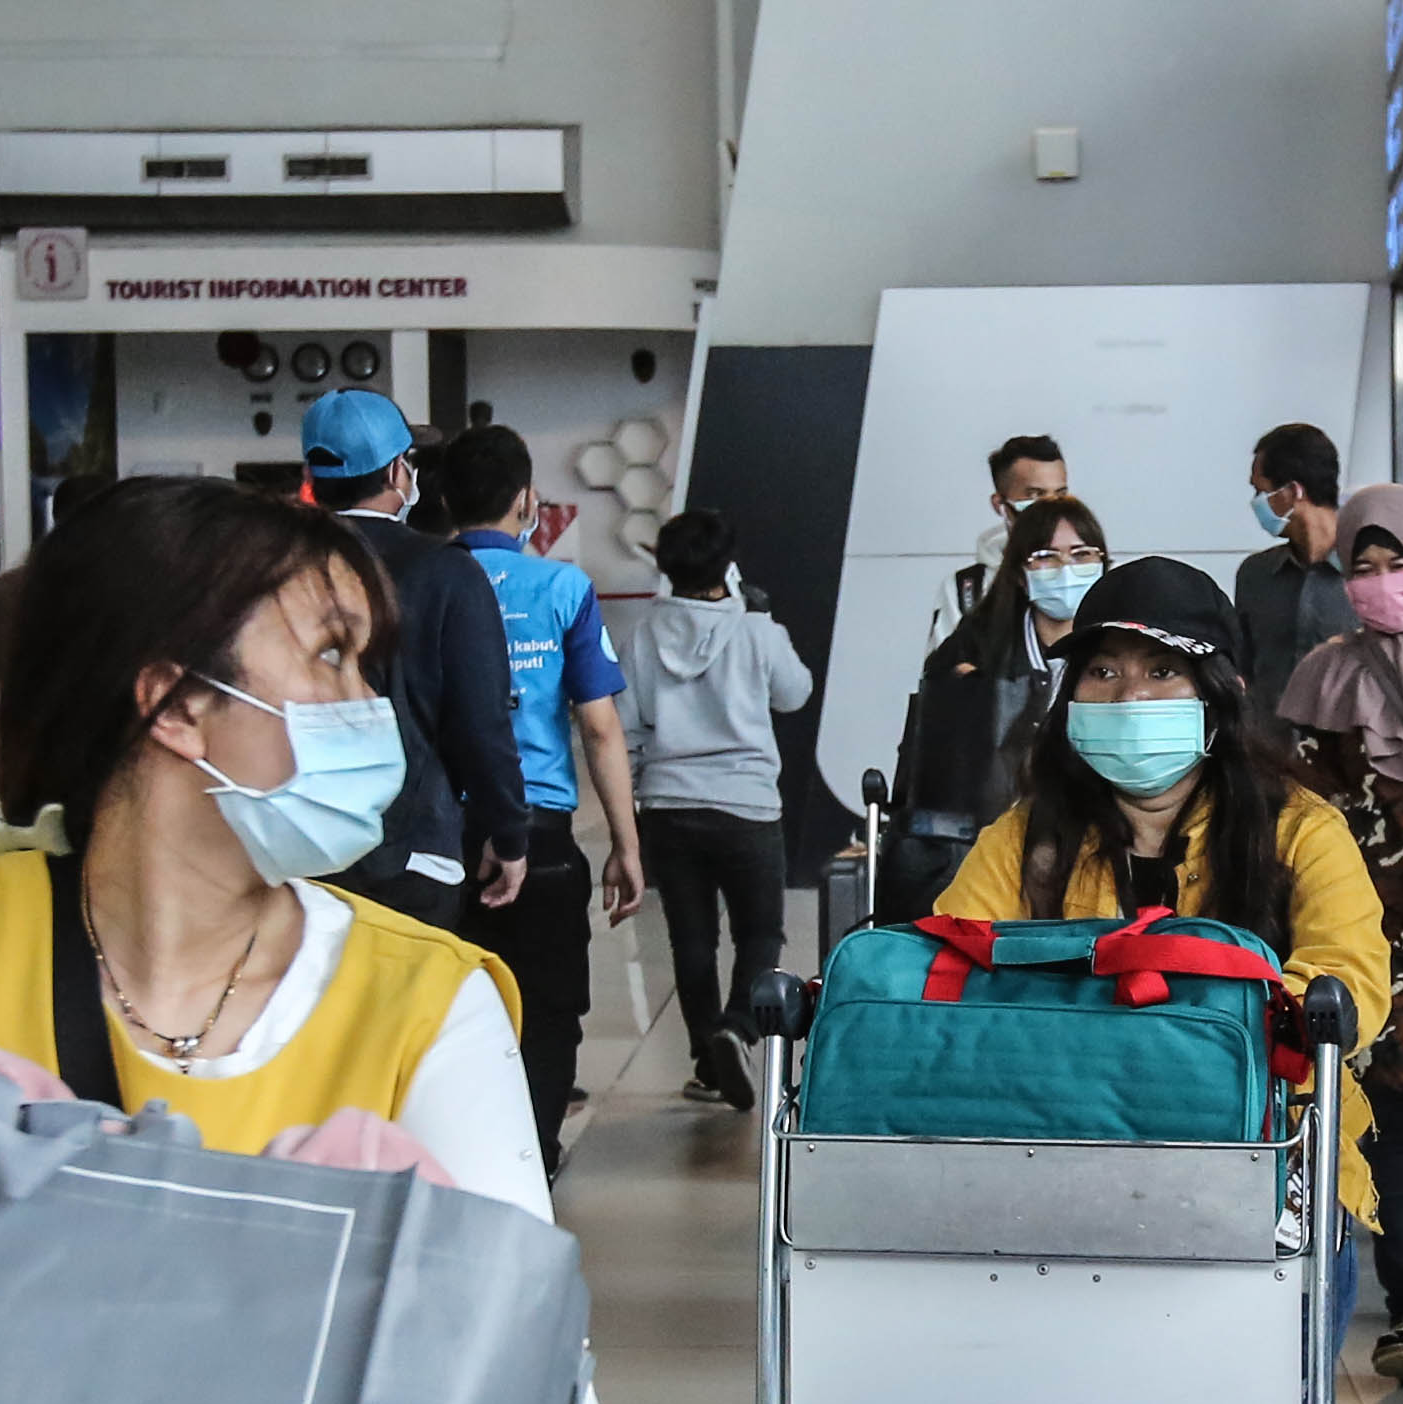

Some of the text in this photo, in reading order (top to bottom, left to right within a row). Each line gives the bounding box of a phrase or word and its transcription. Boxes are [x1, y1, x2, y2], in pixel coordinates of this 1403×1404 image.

[106, 277, 467, 300] TOURIST INFORMATION CENTER
